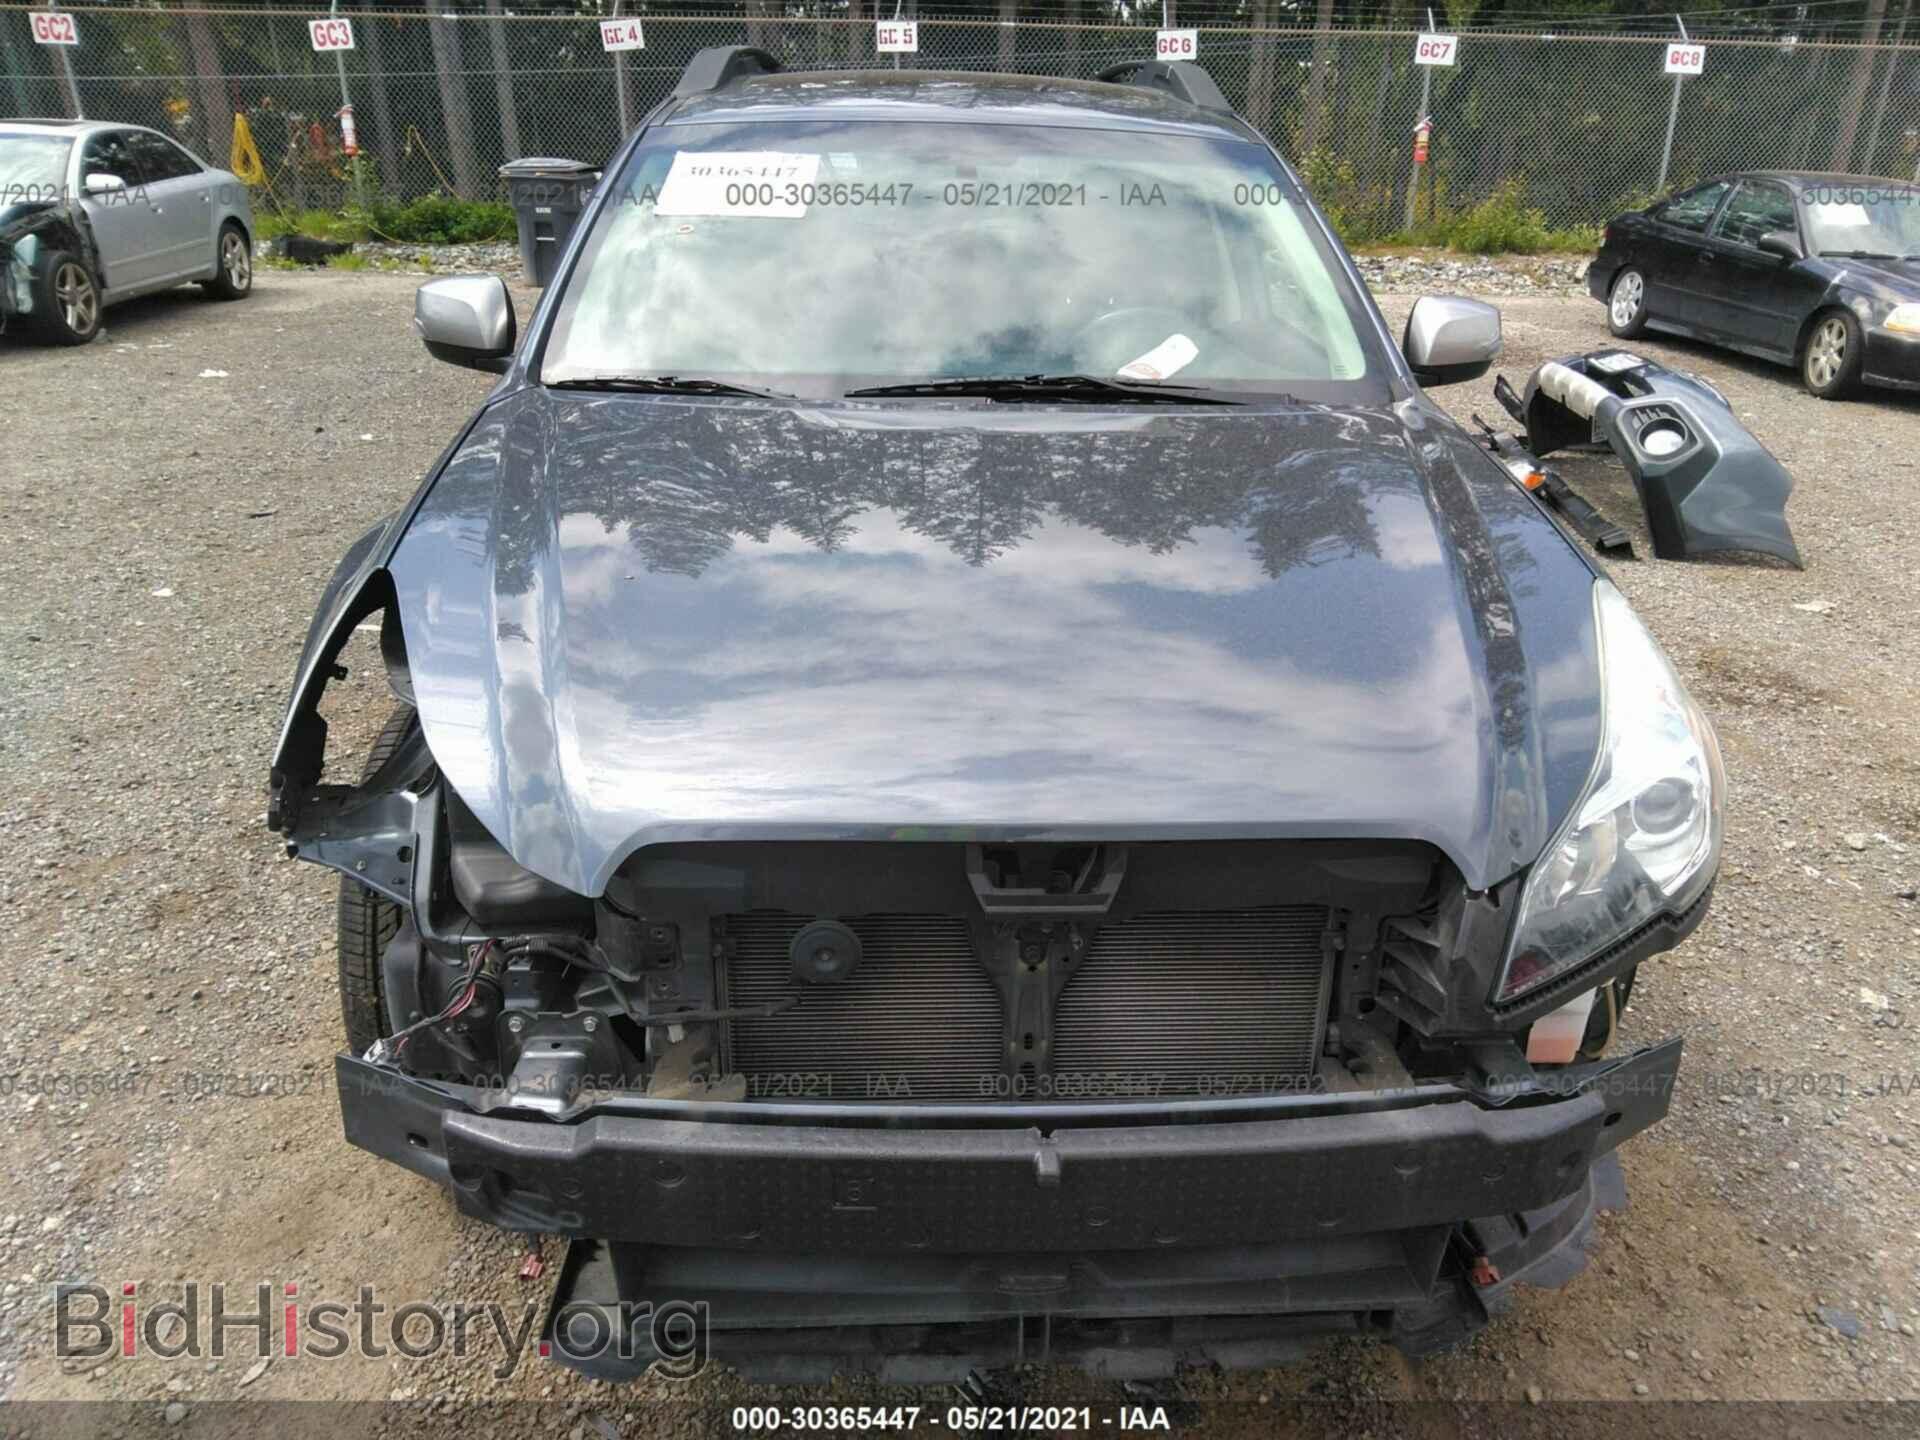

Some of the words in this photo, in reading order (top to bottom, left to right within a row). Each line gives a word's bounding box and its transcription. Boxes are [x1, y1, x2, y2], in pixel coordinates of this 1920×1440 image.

[35, 15, 74, 41] GC2
[313, 21, 350, 47] GC3
[1419, 41, 1451, 58] GC7
